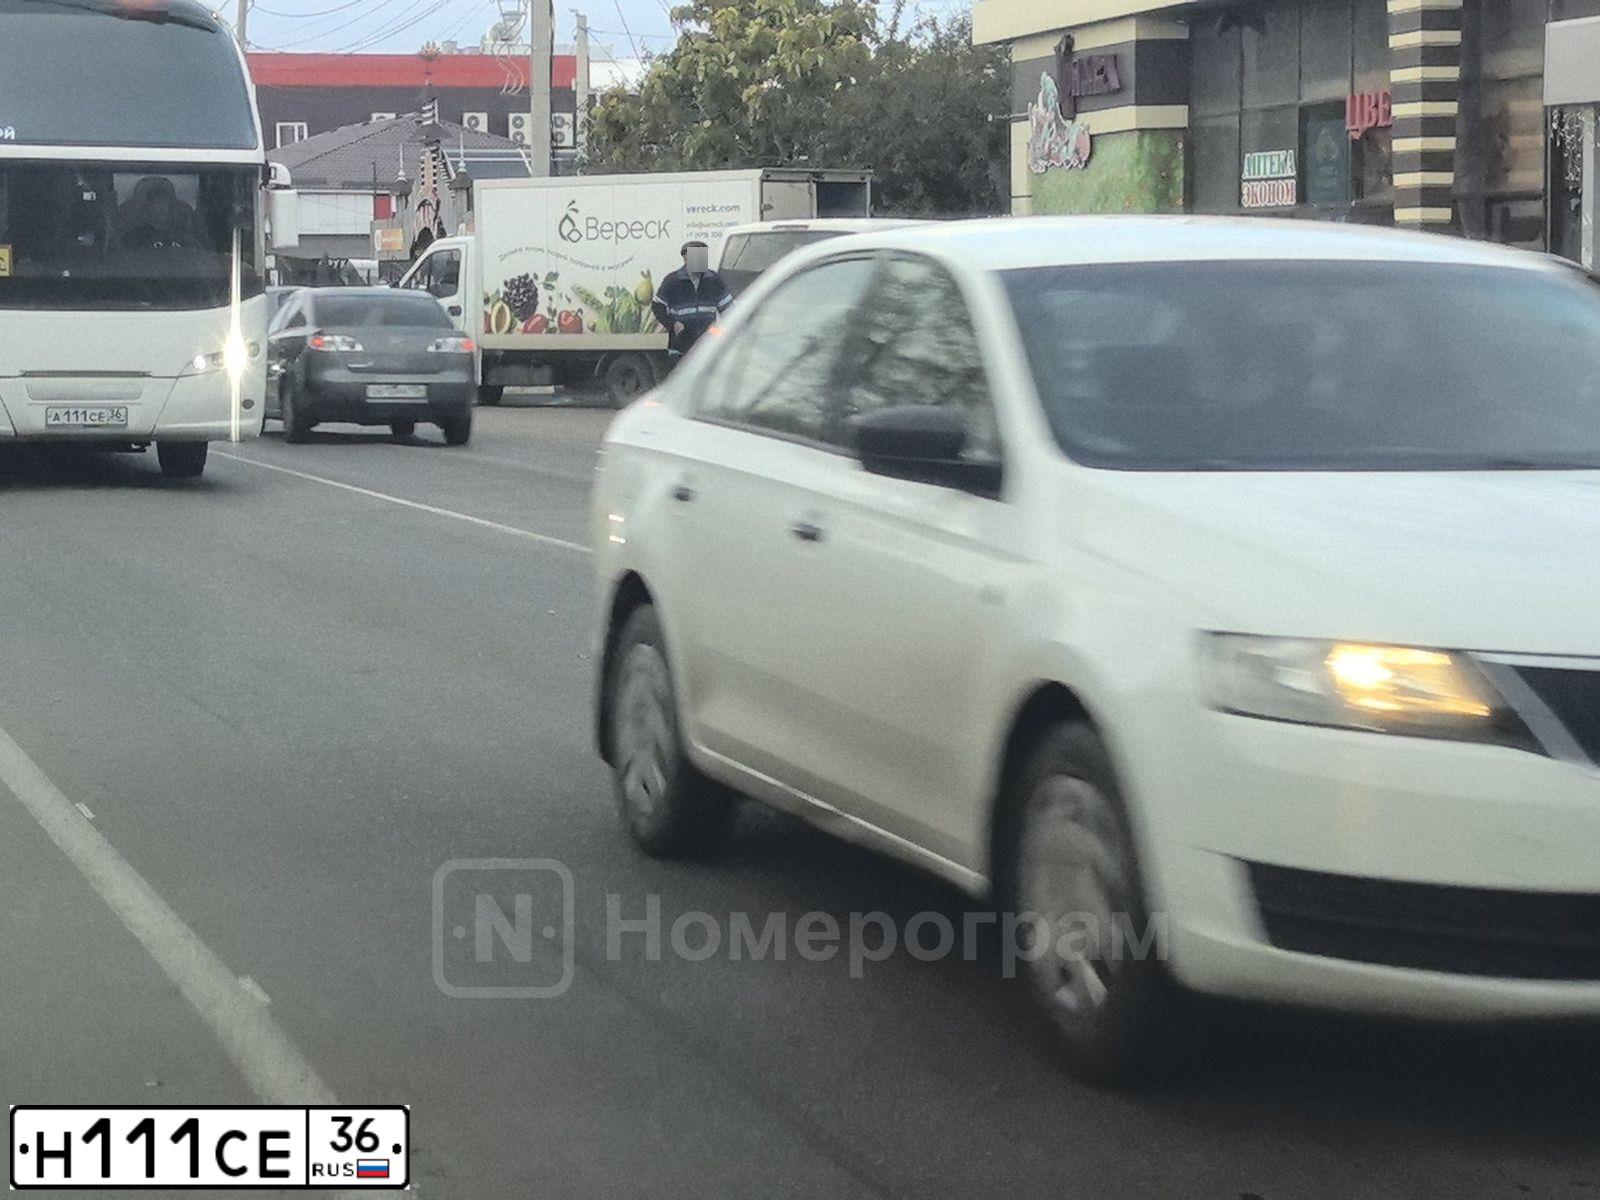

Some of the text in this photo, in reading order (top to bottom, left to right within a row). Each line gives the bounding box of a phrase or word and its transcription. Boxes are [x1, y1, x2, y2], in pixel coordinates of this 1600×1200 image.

[1242, 150, 1296, 179] АПТЕКА
[1241, 180, 1297, 208] ЭКОНОМ
[686, 203, 740, 214] vereck.com
[585, 216, 670, 245] Вереск
